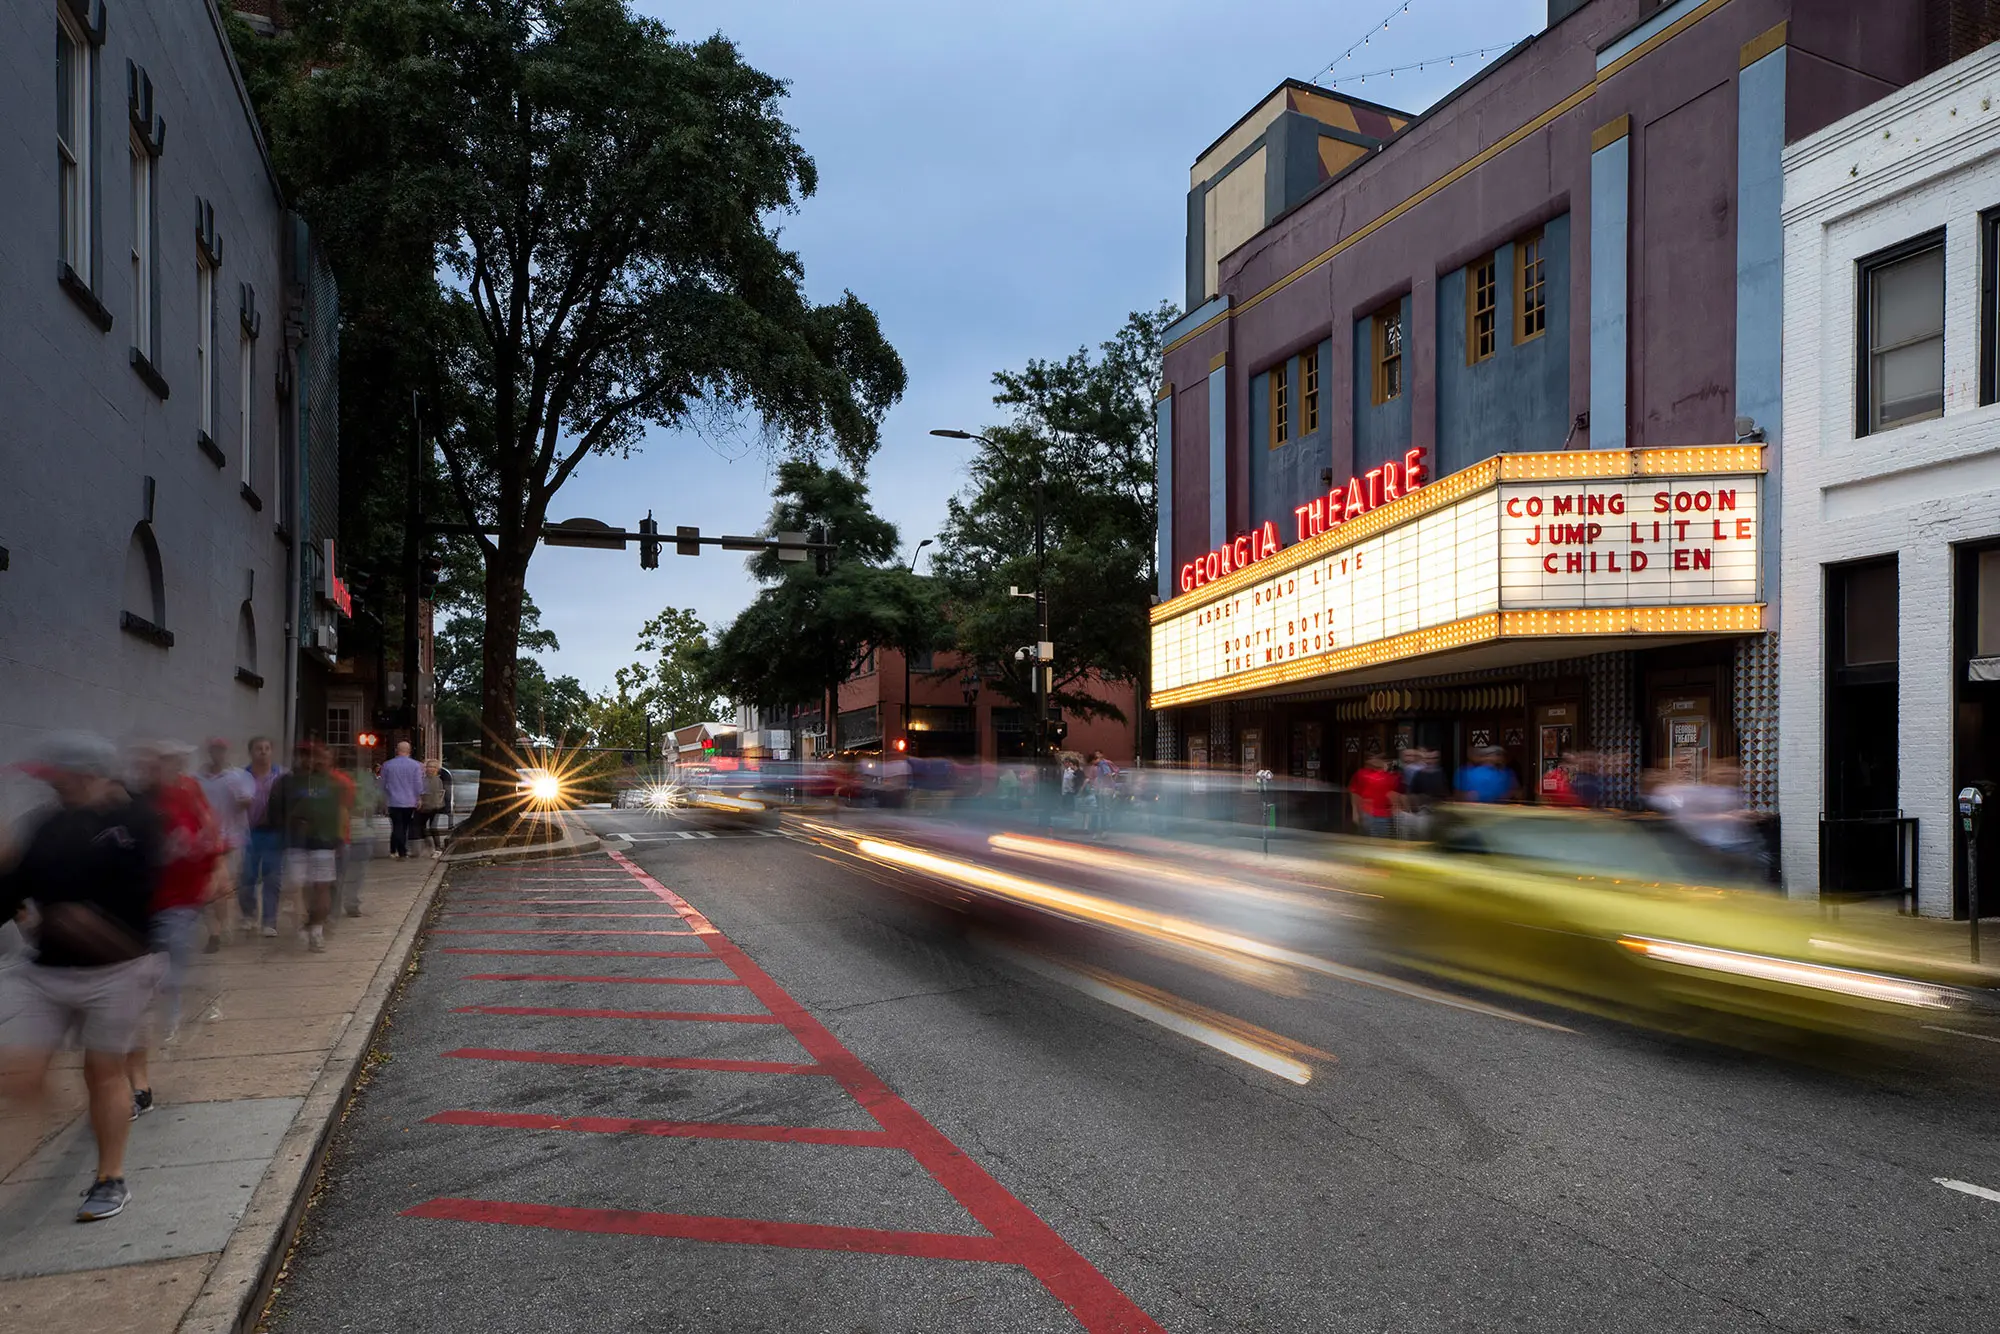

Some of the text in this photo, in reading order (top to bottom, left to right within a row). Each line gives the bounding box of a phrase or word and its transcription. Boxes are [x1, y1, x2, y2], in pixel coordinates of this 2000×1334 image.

[1180, 447, 1426, 593] GEORGIA THEATRE
[1506, 489, 1736, 518] COMING SOON
[1526, 522, 1602, 545] JUMP
[1198, 552, 1363, 626] ABBEY ROAD LIVE
[1225, 608, 1334, 654] BOOTY BOYZ
[1226, 631, 1335, 672] THE MOBROS
[1675, 734, 1697, 743] THEATRE
